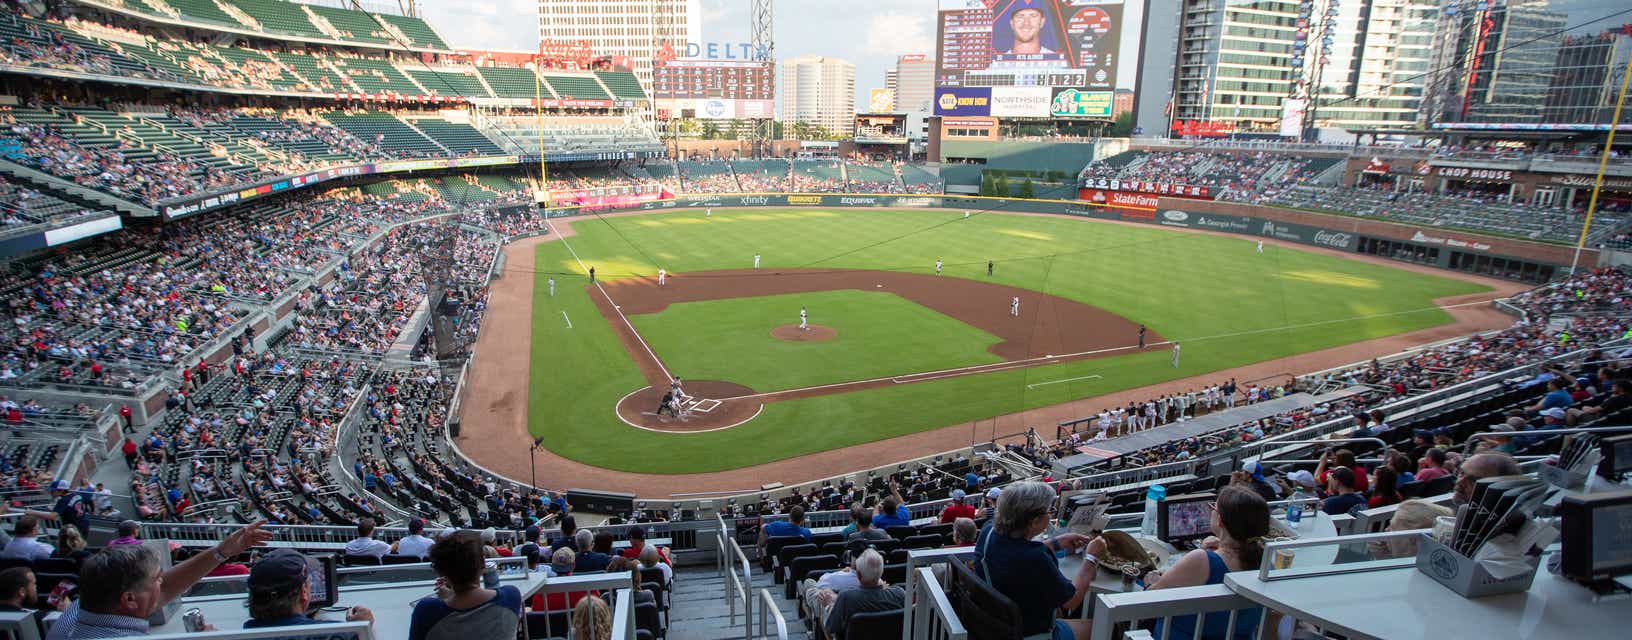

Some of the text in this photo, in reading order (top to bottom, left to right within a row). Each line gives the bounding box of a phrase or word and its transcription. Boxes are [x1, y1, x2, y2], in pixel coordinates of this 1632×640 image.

[1063, 75, 1070, 85] 2
[1075, 75, 1082, 85] 2
[1439, 168, 1513, 181] CHOP HOUSE
[740, 195, 769, 206] xfinity
[840, 197, 875, 205] EQUIFAX
[1206, 219, 1230, 228] Georgia
[1314, 230, 1351, 248] Coca-Cola
